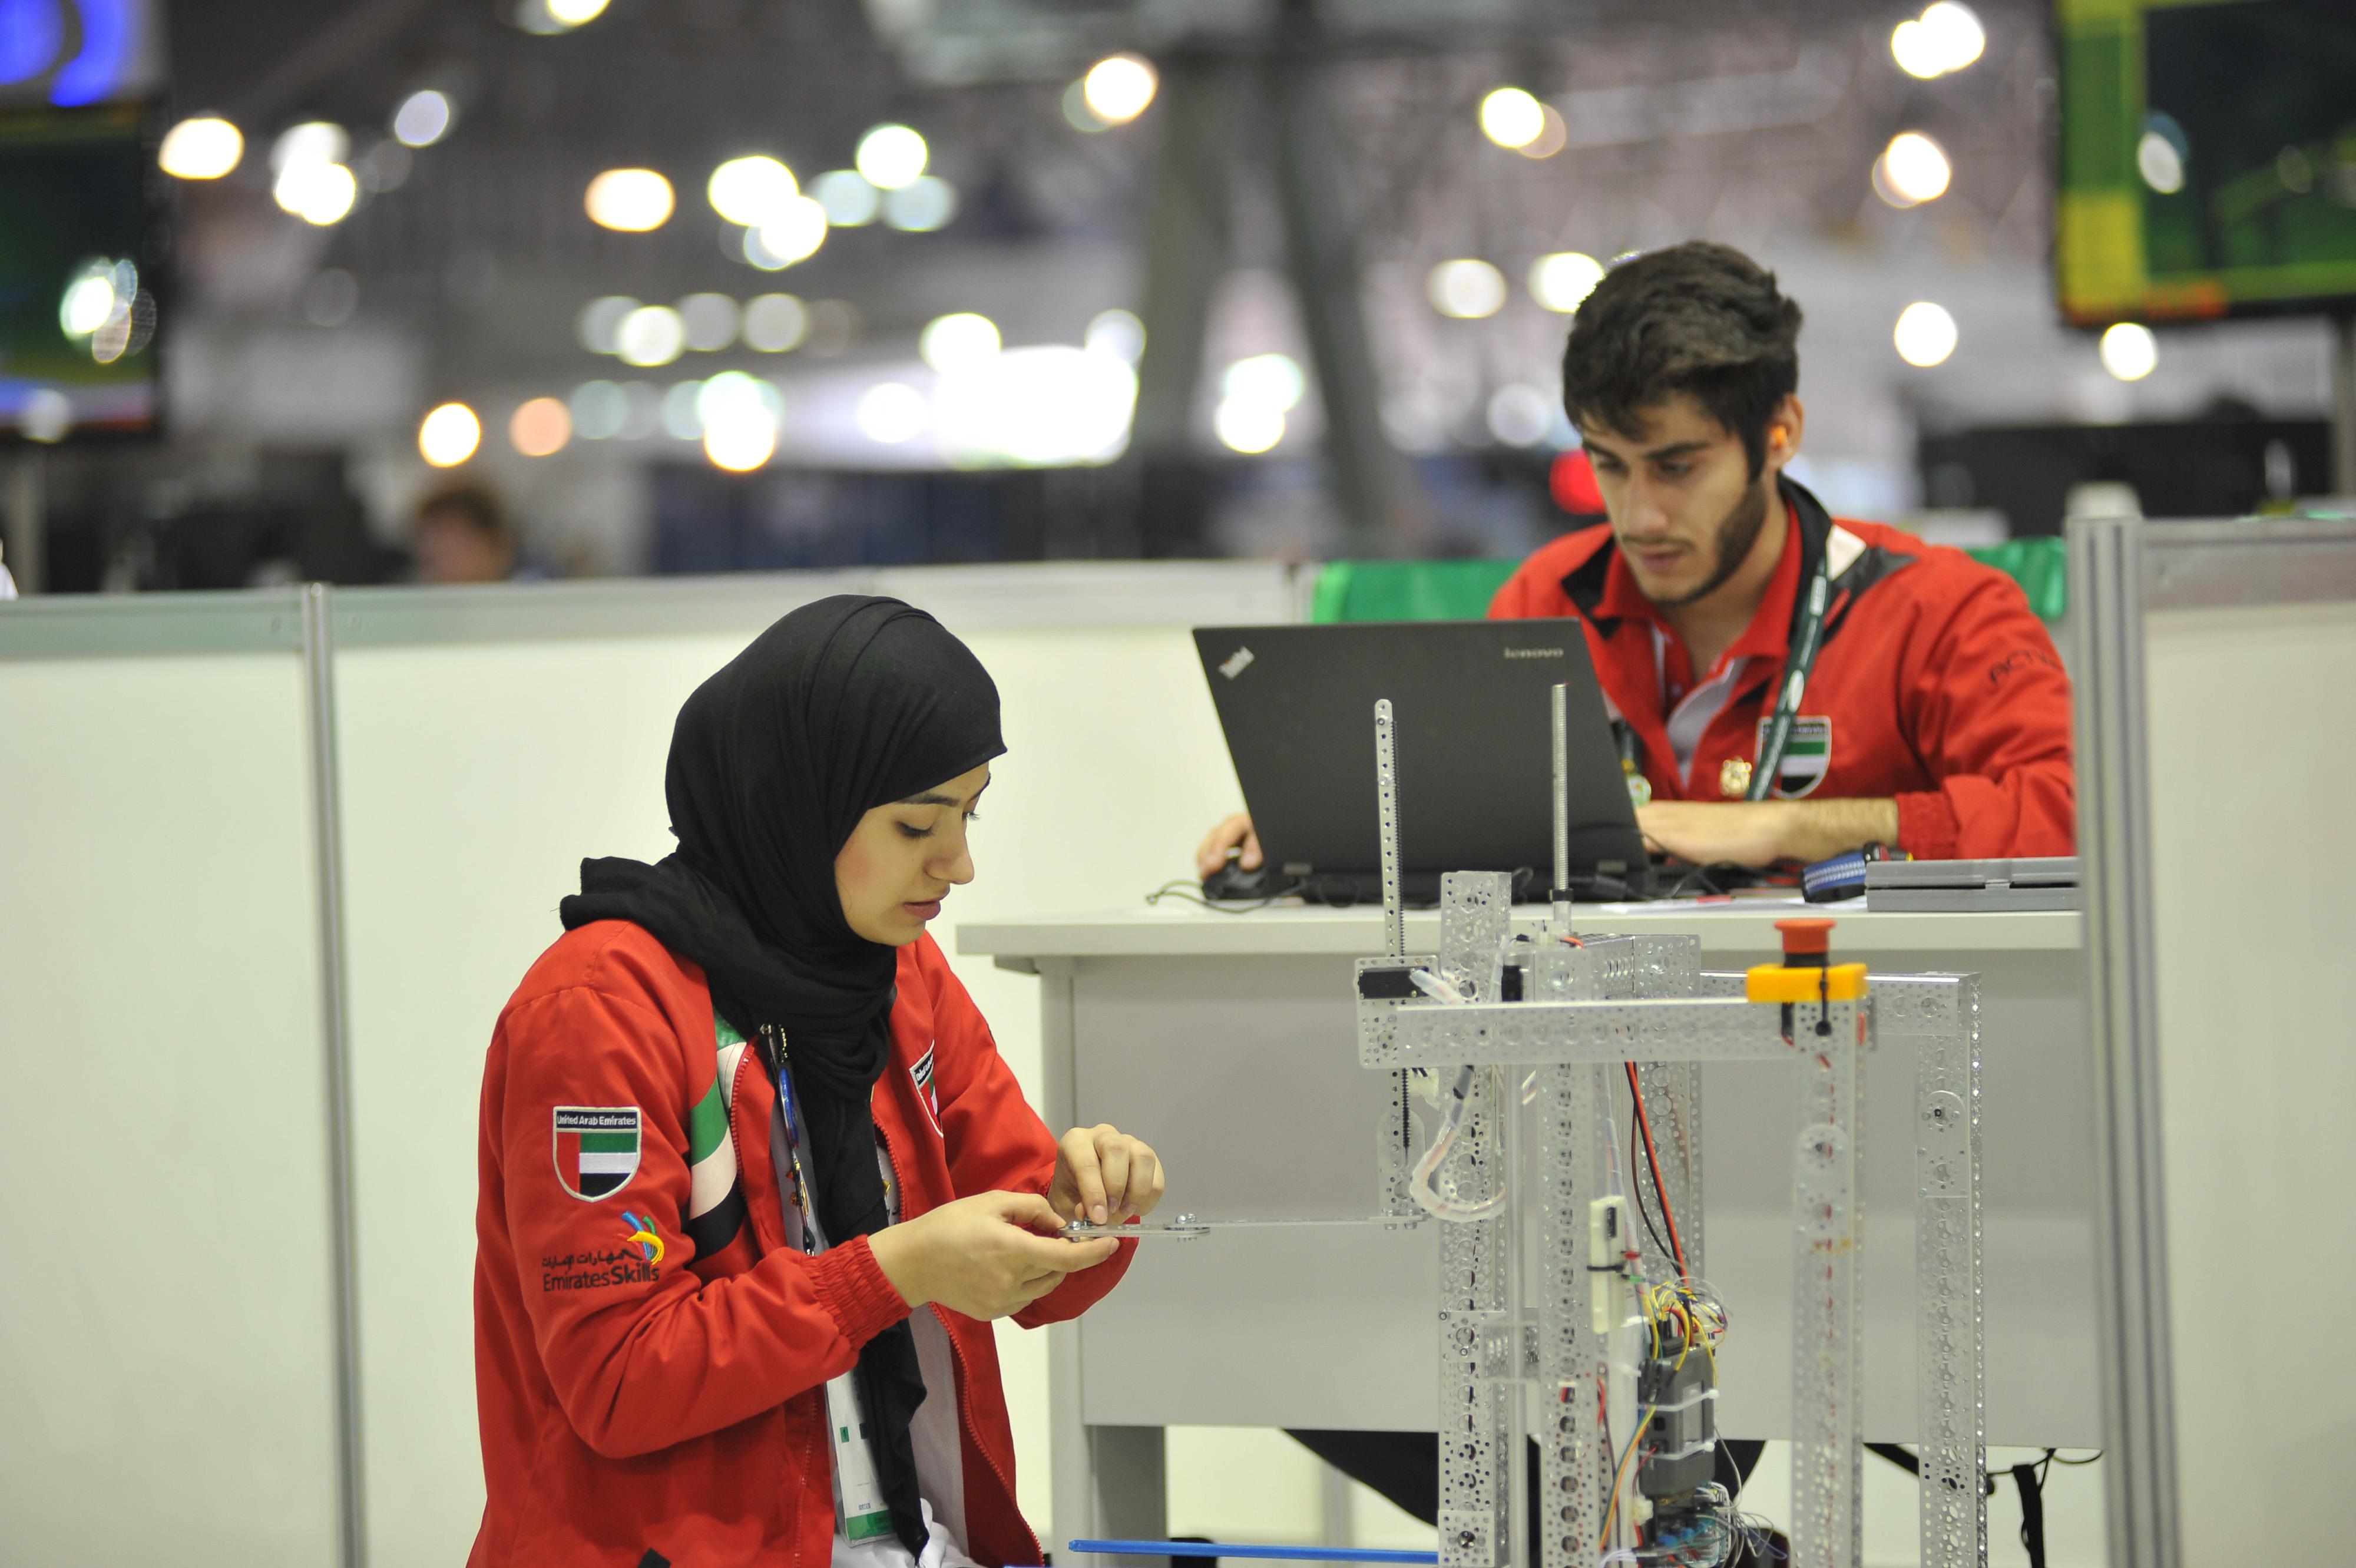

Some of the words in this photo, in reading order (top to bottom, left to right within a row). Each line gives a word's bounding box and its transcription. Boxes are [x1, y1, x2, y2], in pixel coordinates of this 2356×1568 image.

[557, 1114, 578, 1124] United
[579, 1116, 598, 1125] Arab
[599, 1115, 636, 1126] Emirates
